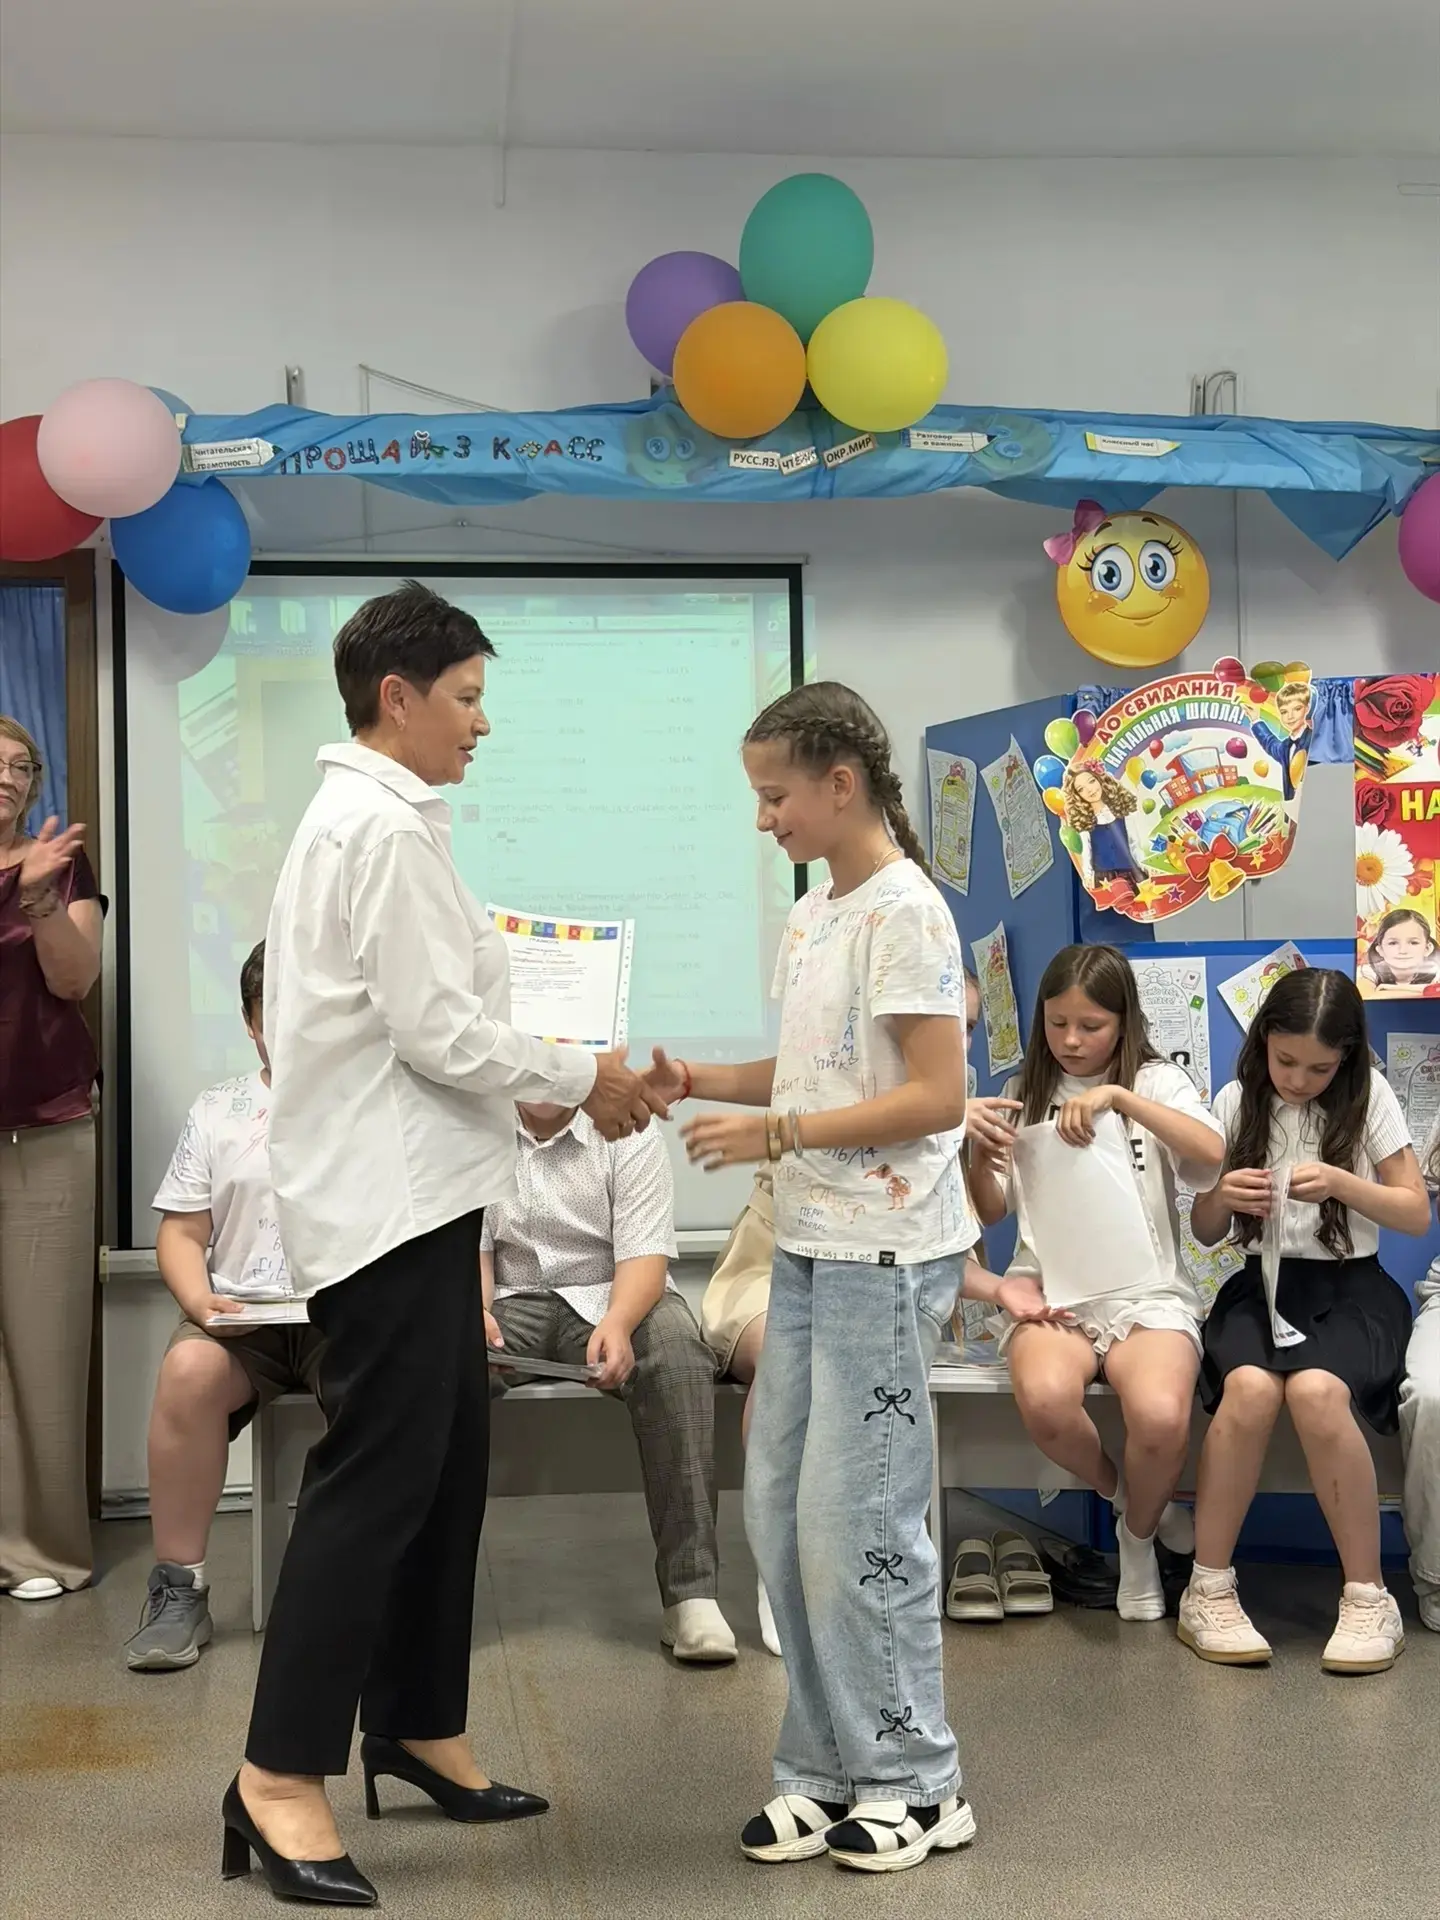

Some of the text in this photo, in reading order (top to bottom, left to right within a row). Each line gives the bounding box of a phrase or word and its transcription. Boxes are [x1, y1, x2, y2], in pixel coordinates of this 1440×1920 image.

[1097, 681, 1240, 745] ДО СВИДАНИЯ,
[1104, 702, 1246, 768] НАЧАЛЬНАЯ ШКОЛА!
